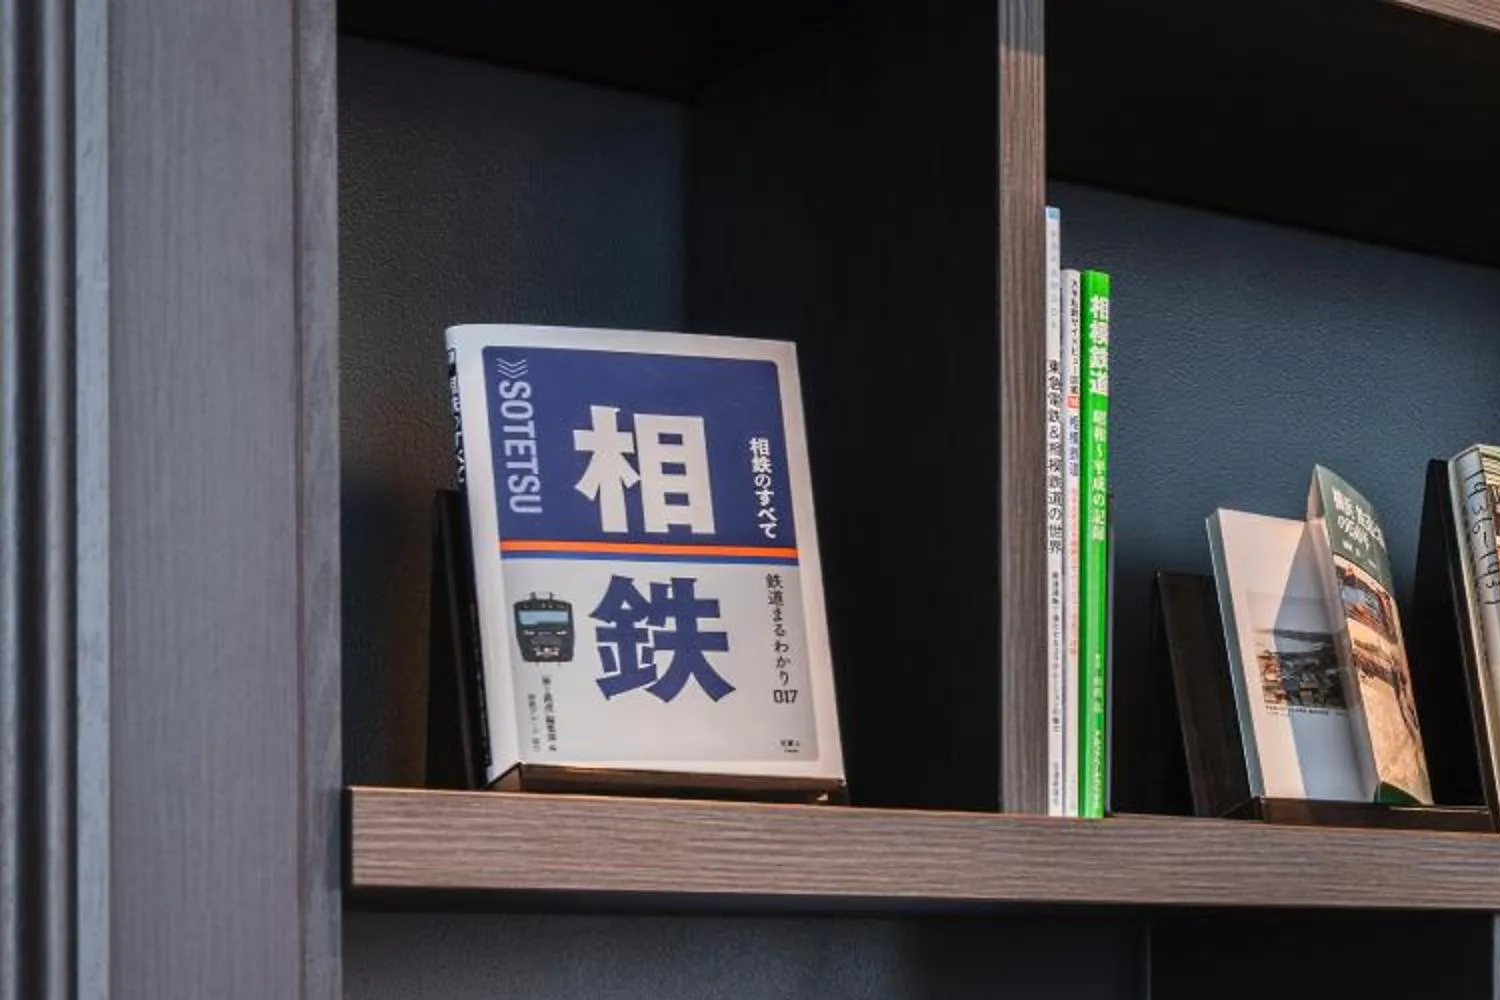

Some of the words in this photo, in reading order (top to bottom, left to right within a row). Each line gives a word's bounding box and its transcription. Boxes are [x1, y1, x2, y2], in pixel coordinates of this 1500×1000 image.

[498, 381, 543, 514] SOTETSU
[748, 436, 777, 540] 相鉄のすべて
[766, 573, 790, 686] 鉄道まるわかり
